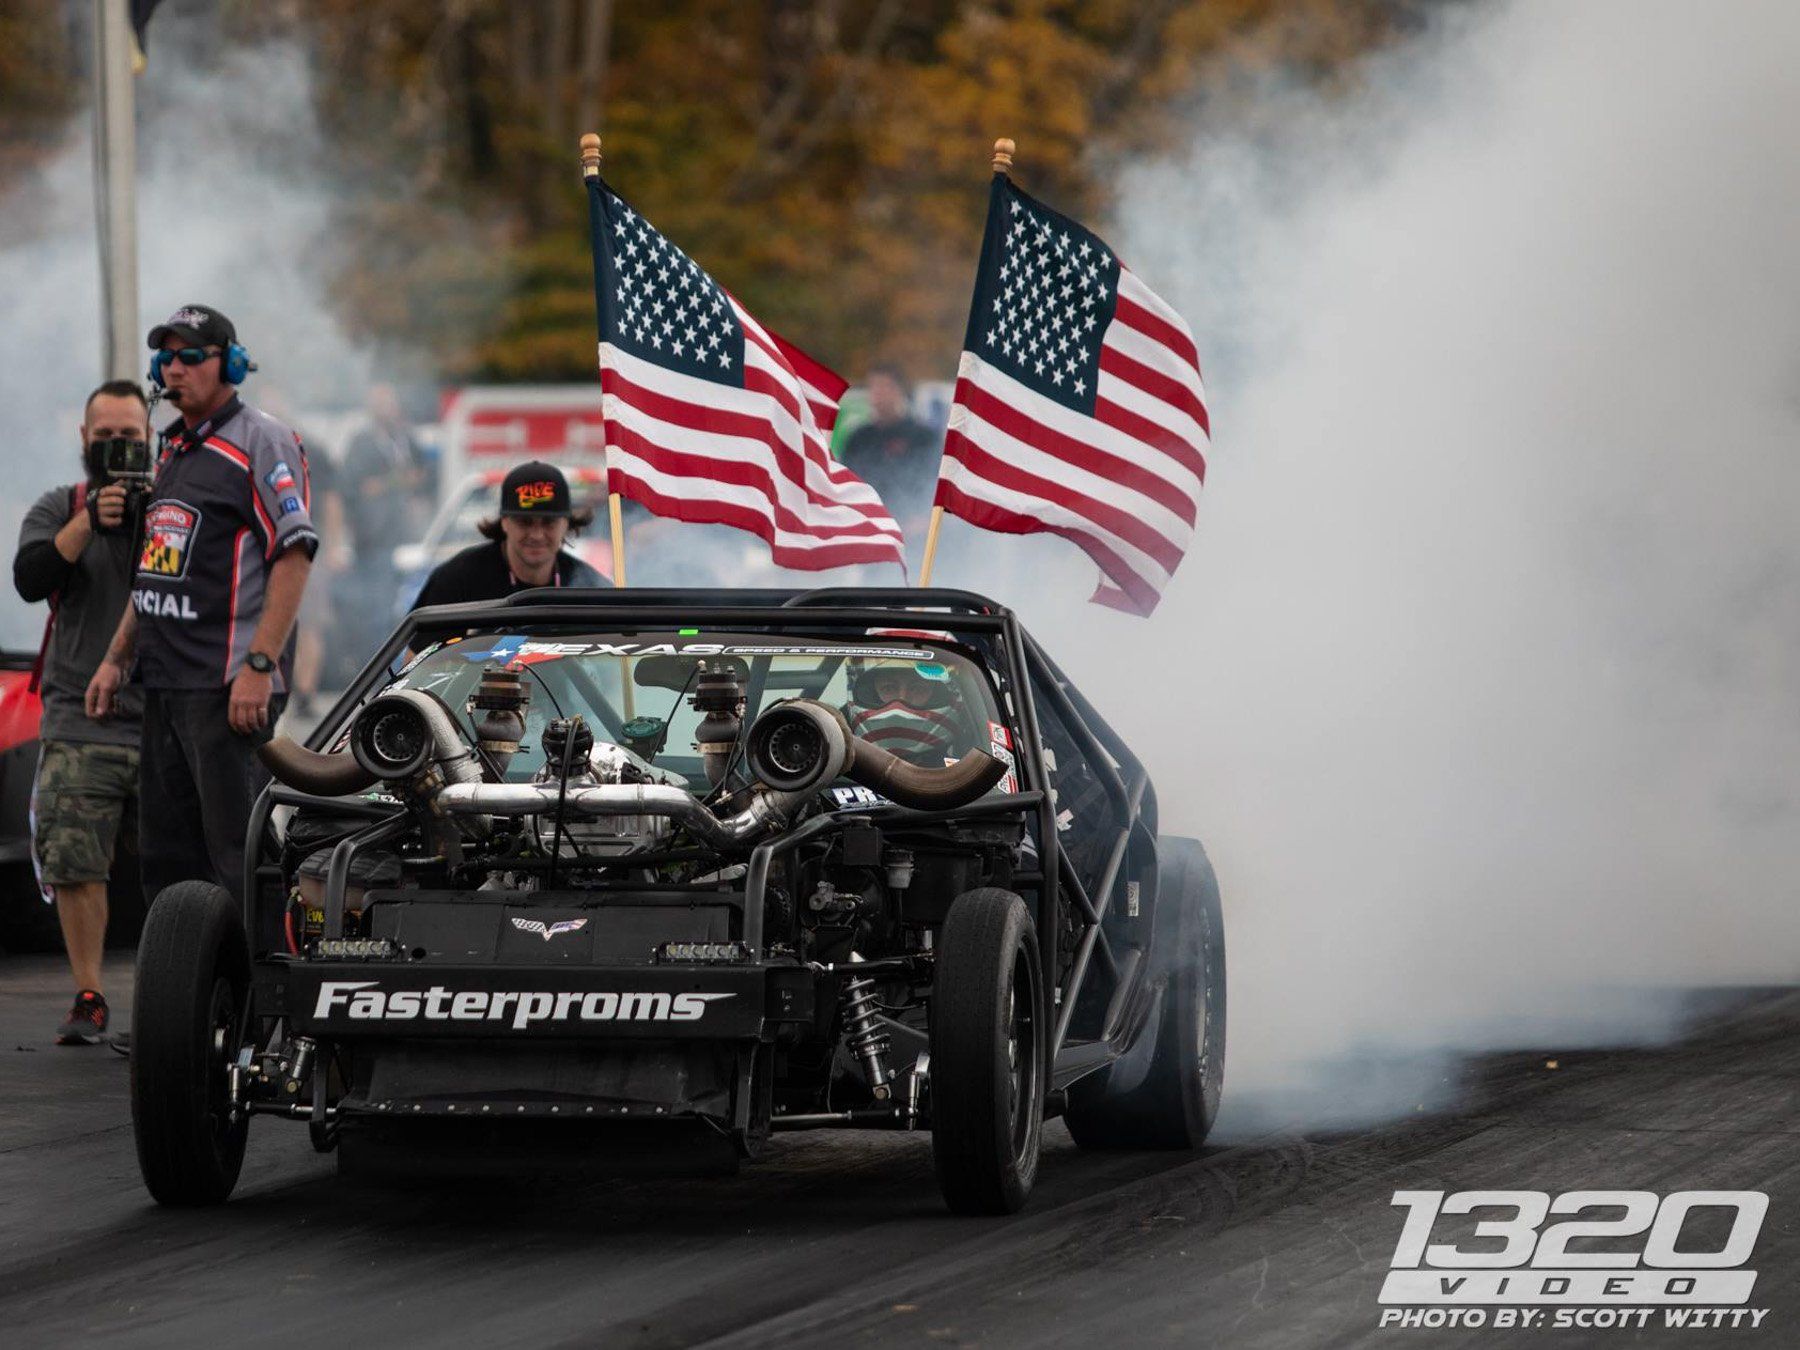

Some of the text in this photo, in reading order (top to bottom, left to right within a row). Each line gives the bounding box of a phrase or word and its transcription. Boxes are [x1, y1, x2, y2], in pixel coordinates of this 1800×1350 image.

[517, 643, 724, 655] TEXAS
[804, 648, 925, 657] PERFORMANCE
[313, 981, 738, 1029] Fasterproms
